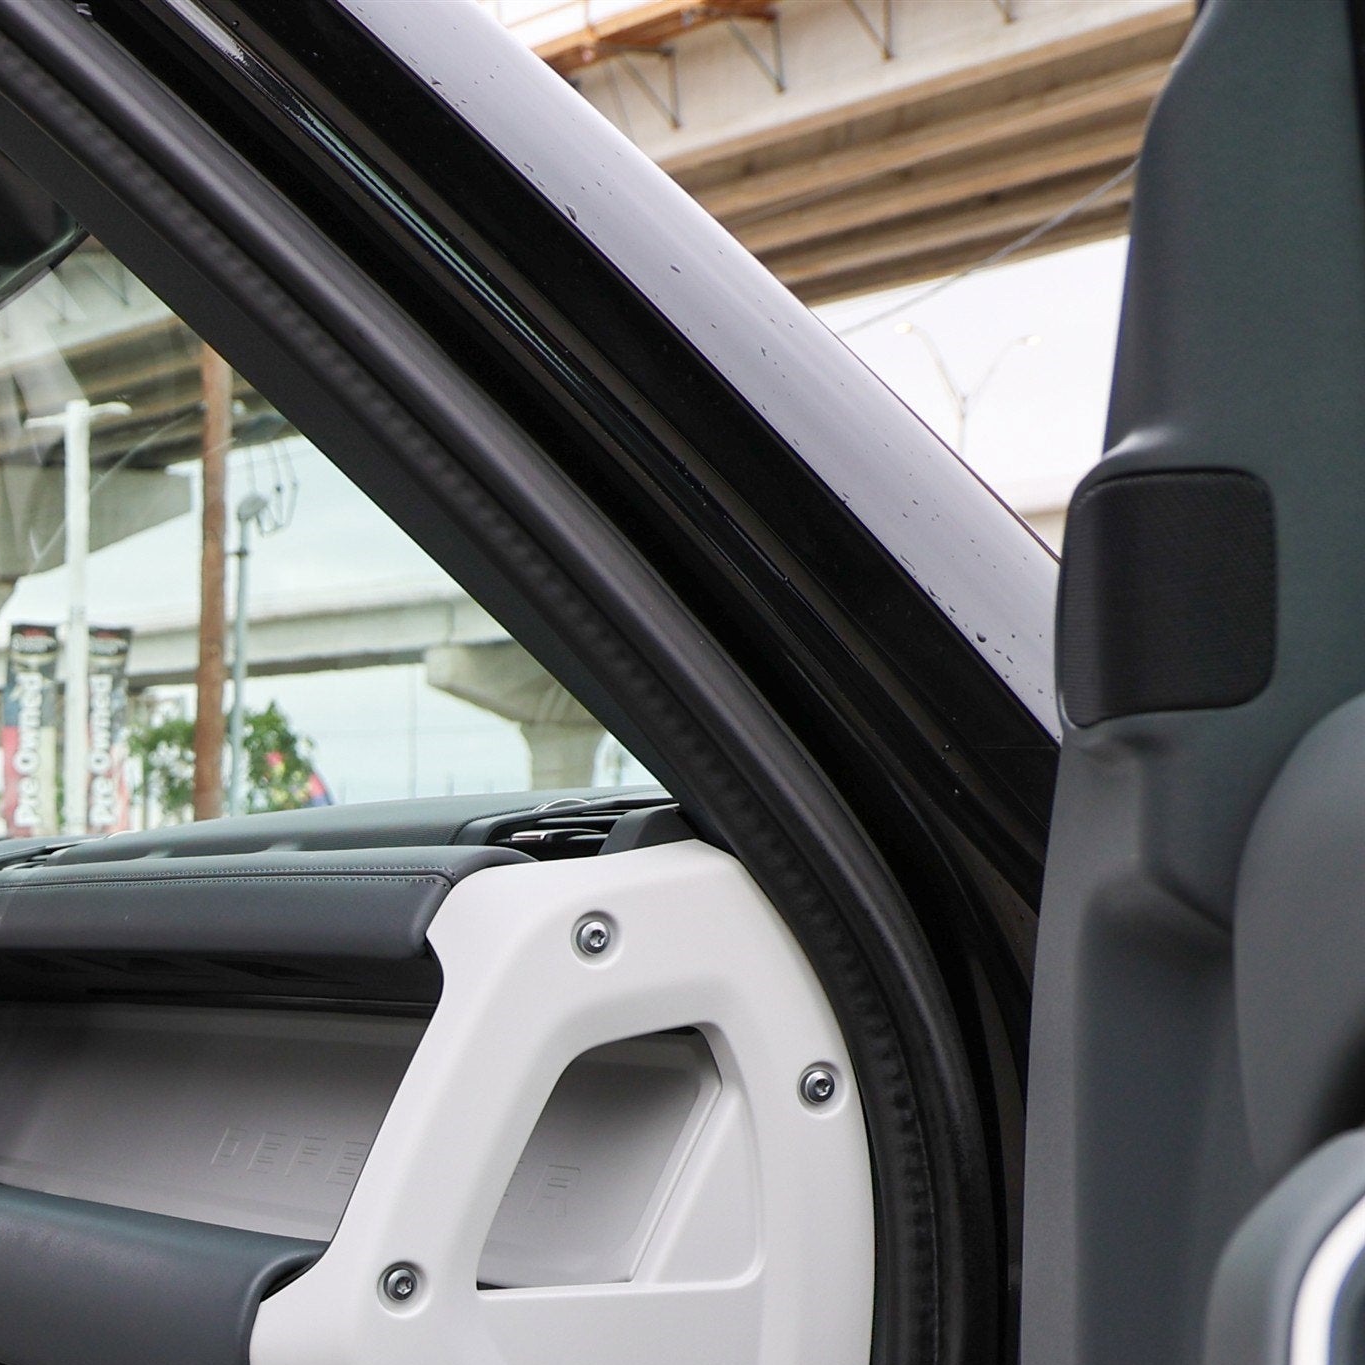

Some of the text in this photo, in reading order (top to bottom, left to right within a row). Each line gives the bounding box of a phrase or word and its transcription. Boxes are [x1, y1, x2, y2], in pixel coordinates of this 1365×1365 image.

[13, 673, 43, 775] Owned
[88, 675, 113, 774] Owned
[14, 777, 42, 827] Pre
[90, 776, 117, 826] Pre
